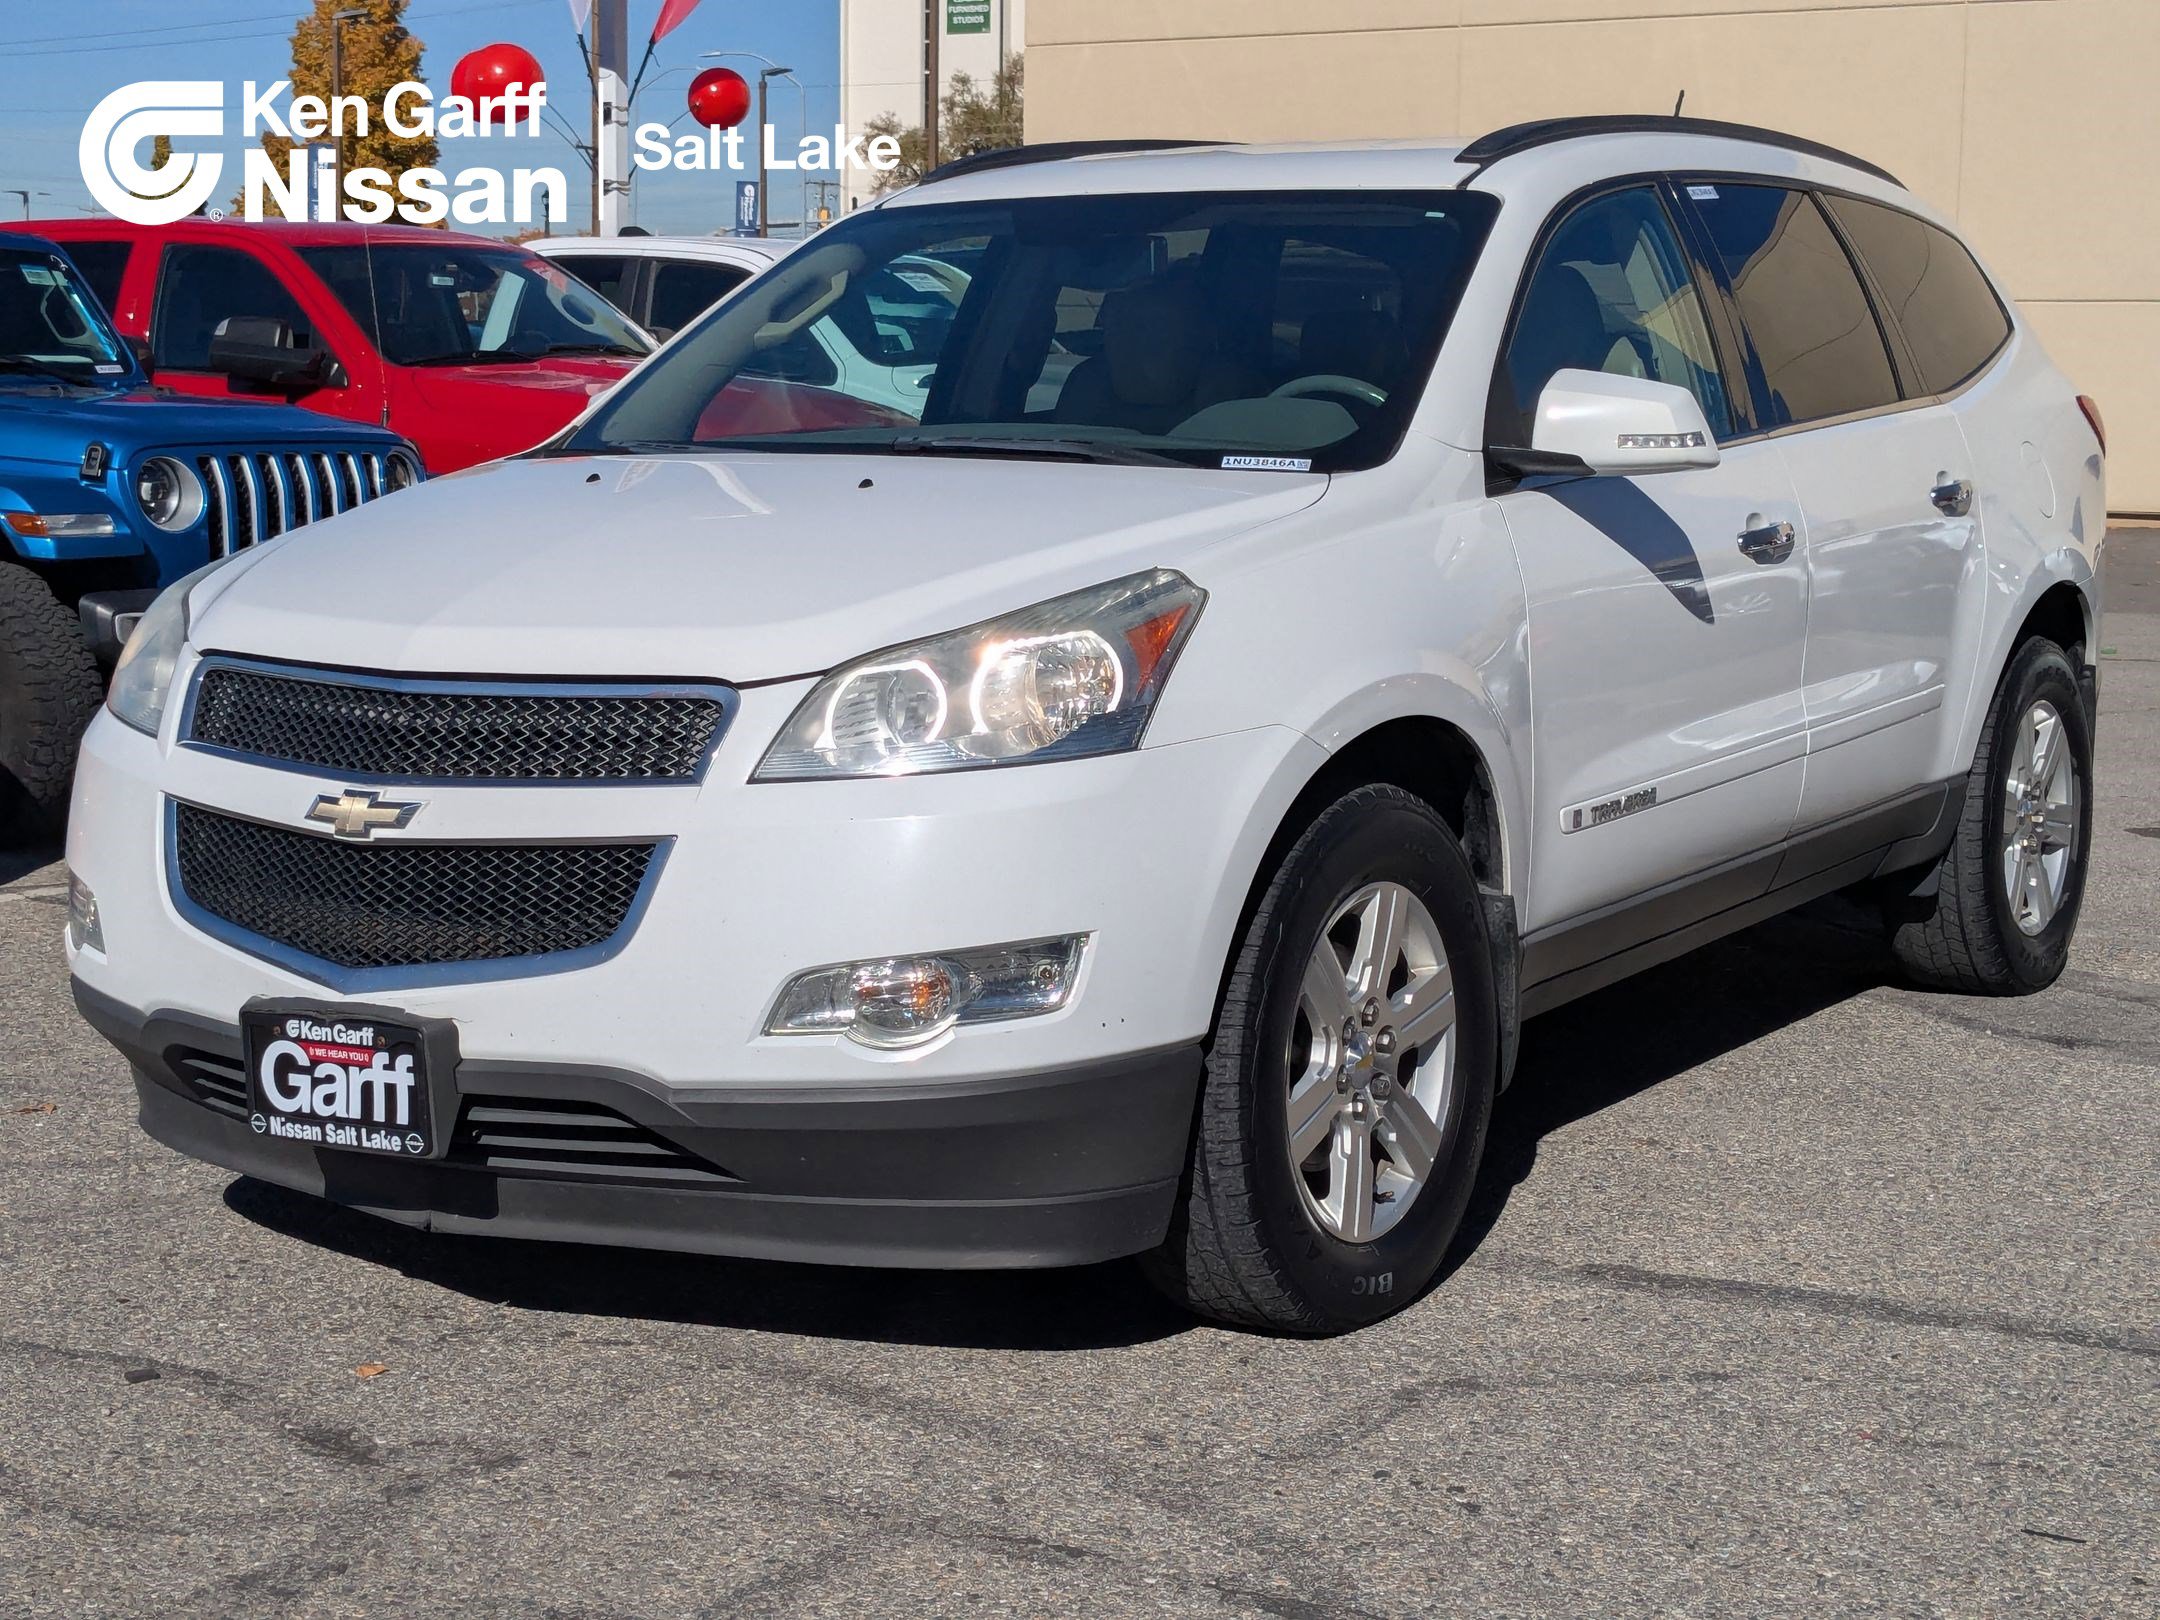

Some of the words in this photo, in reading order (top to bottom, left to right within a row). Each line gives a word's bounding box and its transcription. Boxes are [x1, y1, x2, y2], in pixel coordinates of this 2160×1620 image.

[948, 5, 990, 13] FURNISHED
[953, 16, 985, 24] STUDIOS
[1223, 457, 1296, 467] 1NU3846A
[300, 1020, 333, 1042] Ken
[333, 1024, 374, 1046] Garff
[315, 1048, 327, 1057] WE
[327, 1049, 348, 1060] HEAR
[349, 1051, 364, 1061] YOU
[261, 1039, 415, 1126] Garff
[269, 1115, 322, 1142] Nissan
[325, 1122, 358, 1146] Salt
[361, 1127, 402, 1151] Lake
